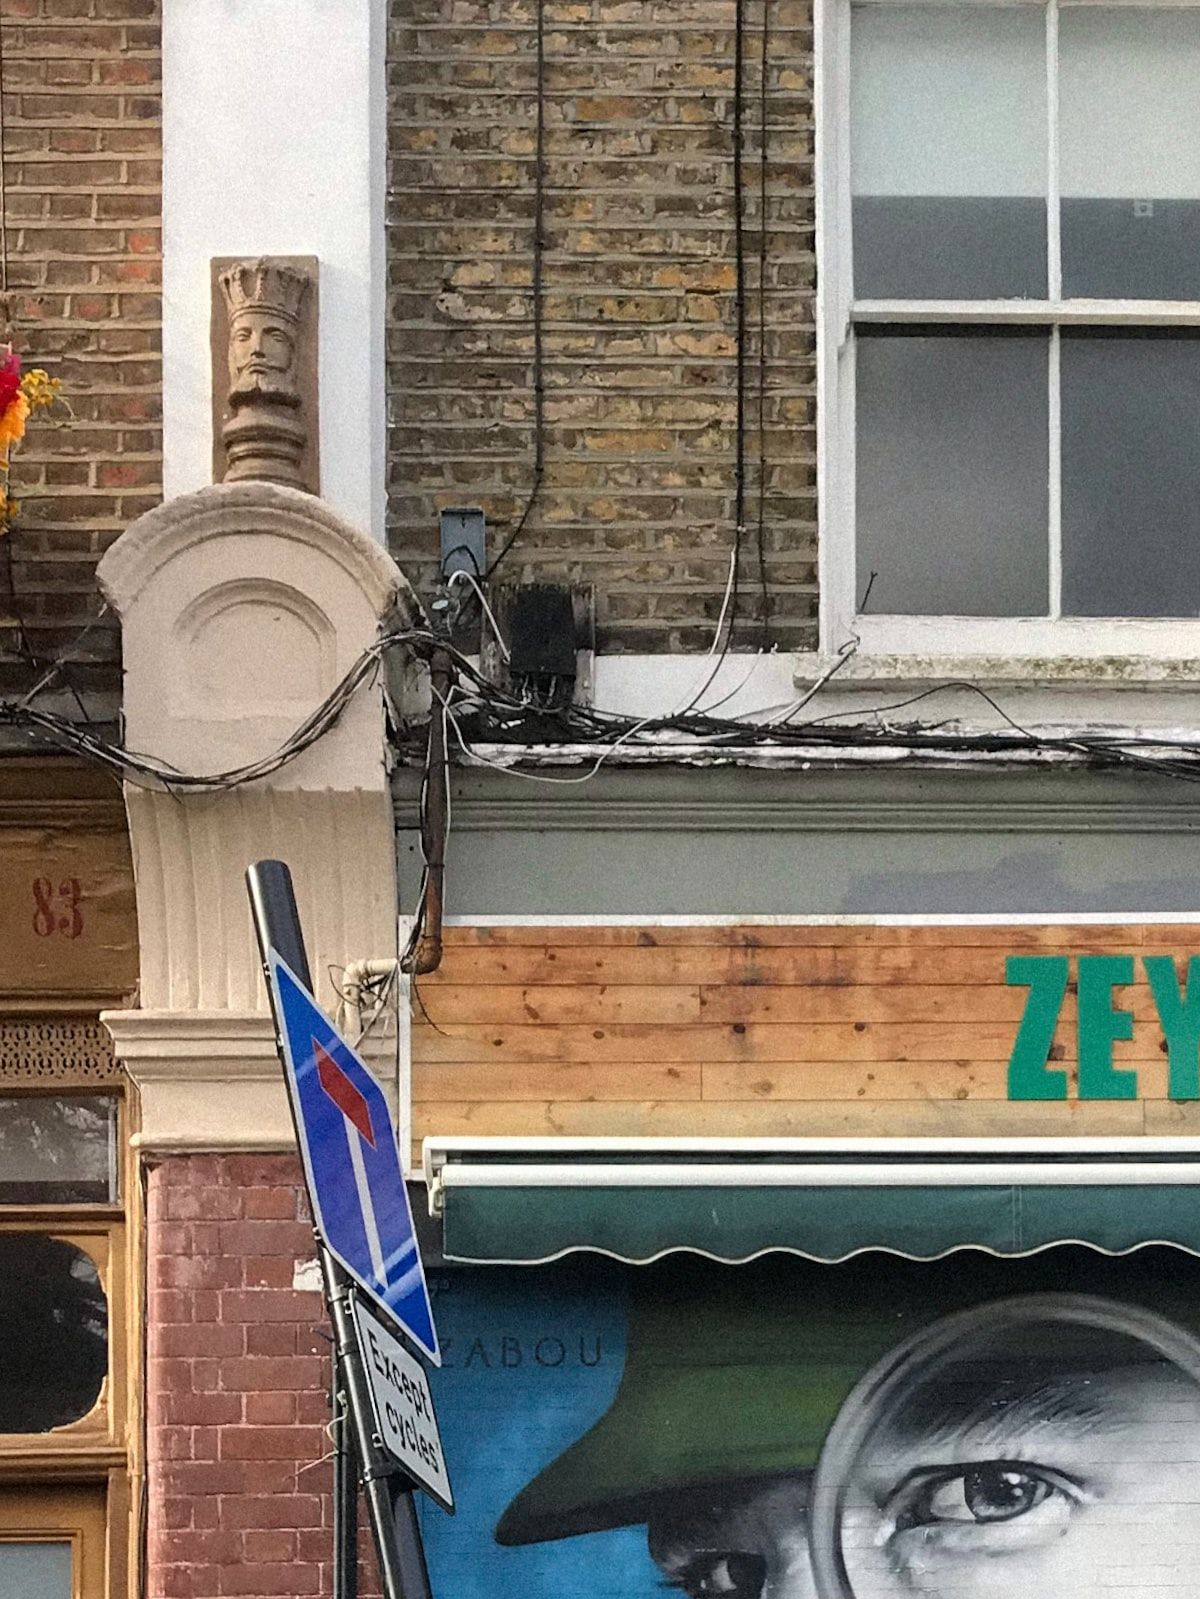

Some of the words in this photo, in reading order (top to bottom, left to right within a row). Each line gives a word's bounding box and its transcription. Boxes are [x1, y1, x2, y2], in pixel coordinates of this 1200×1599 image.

[33, 877, 84, 939] 83
[367, 1326, 432, 1423] Except
[385, 1401, 441, 1475] cycles
